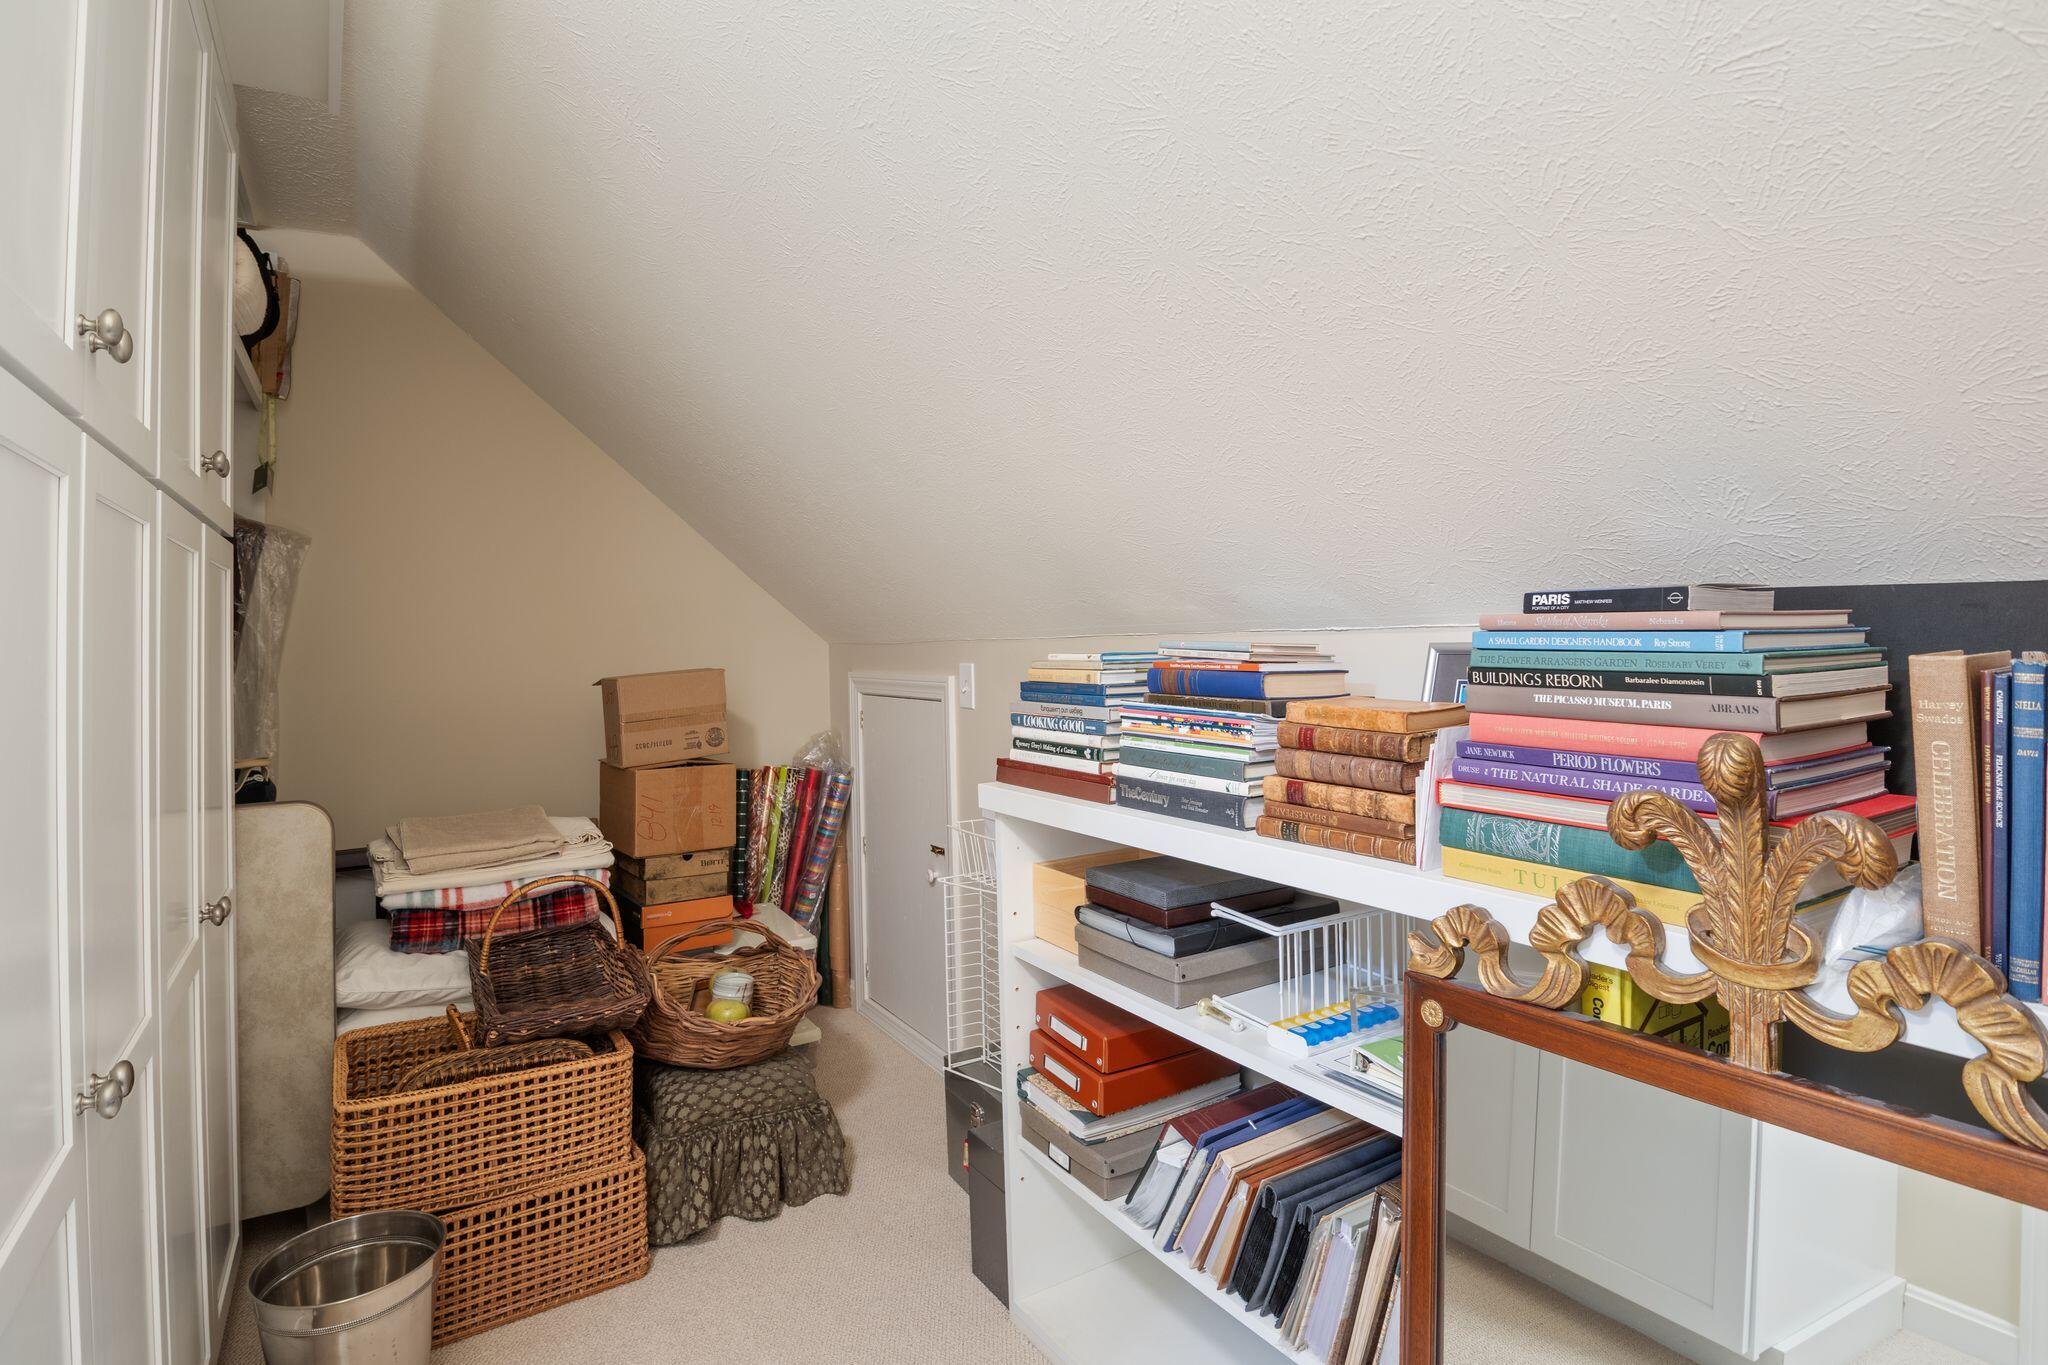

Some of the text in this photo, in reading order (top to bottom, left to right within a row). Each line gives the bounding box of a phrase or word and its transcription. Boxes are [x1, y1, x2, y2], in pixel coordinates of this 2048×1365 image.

[1532, 593, 1570, 606] PARIS
[1649, 617, 1684, 626] Nebraska
[1519, 638, 1550, 646] GARDEN
[1552, 638, 1592, 646] DESIGNER'S
[1594, 638, 1642, 647] HANDBOOK
[1654, 638, 1690, 648] Roy Strong
[1480, 654, 1727, 670] THE FLOWER ARRANGER'S GARDEN ROSEMARY VEREY
[1472, 671, 1604, 688] BUILDINGS REBORN
[1624, 676, 1704, 686] Barbaralee Diamonstein
[1534, 694, 1672, 710] THE PICASSO MUSEUM, PARIS
[1918, 700, 1964, 712] Harvey
[2014, 700, 2042, 711] STELLA
[1709, 704, 1760, 714] ABRAMS
[1024, 715, 1059, 730] LOOKING
[1060, 718, 1084, 733] GOOD
[1916, 712, 1964, 726] Swados
[1063, 746, 1078, 755] Garden
[2016, 749, 2039, 758] DAVIS
[1465, 746, 1662, 777] JANE NEWDICK PERIOD FLOWERS
[1996, 754, 2004, 786] PELICANS
[1458, 766, 1480, 774] DRUSE
[1491, 768, 1518, 780] THE
[1521, 772, 1590, 790] NATURAL
[1592, 778, 1644, 794] SHADE
[1996, 786, 2004, 800] ARE
[1931, 740, 1958, 902] CELEBRATION
[1996, 801, 2004, 828] SCARCE
[1590, 974, 1614, 984] ader's
